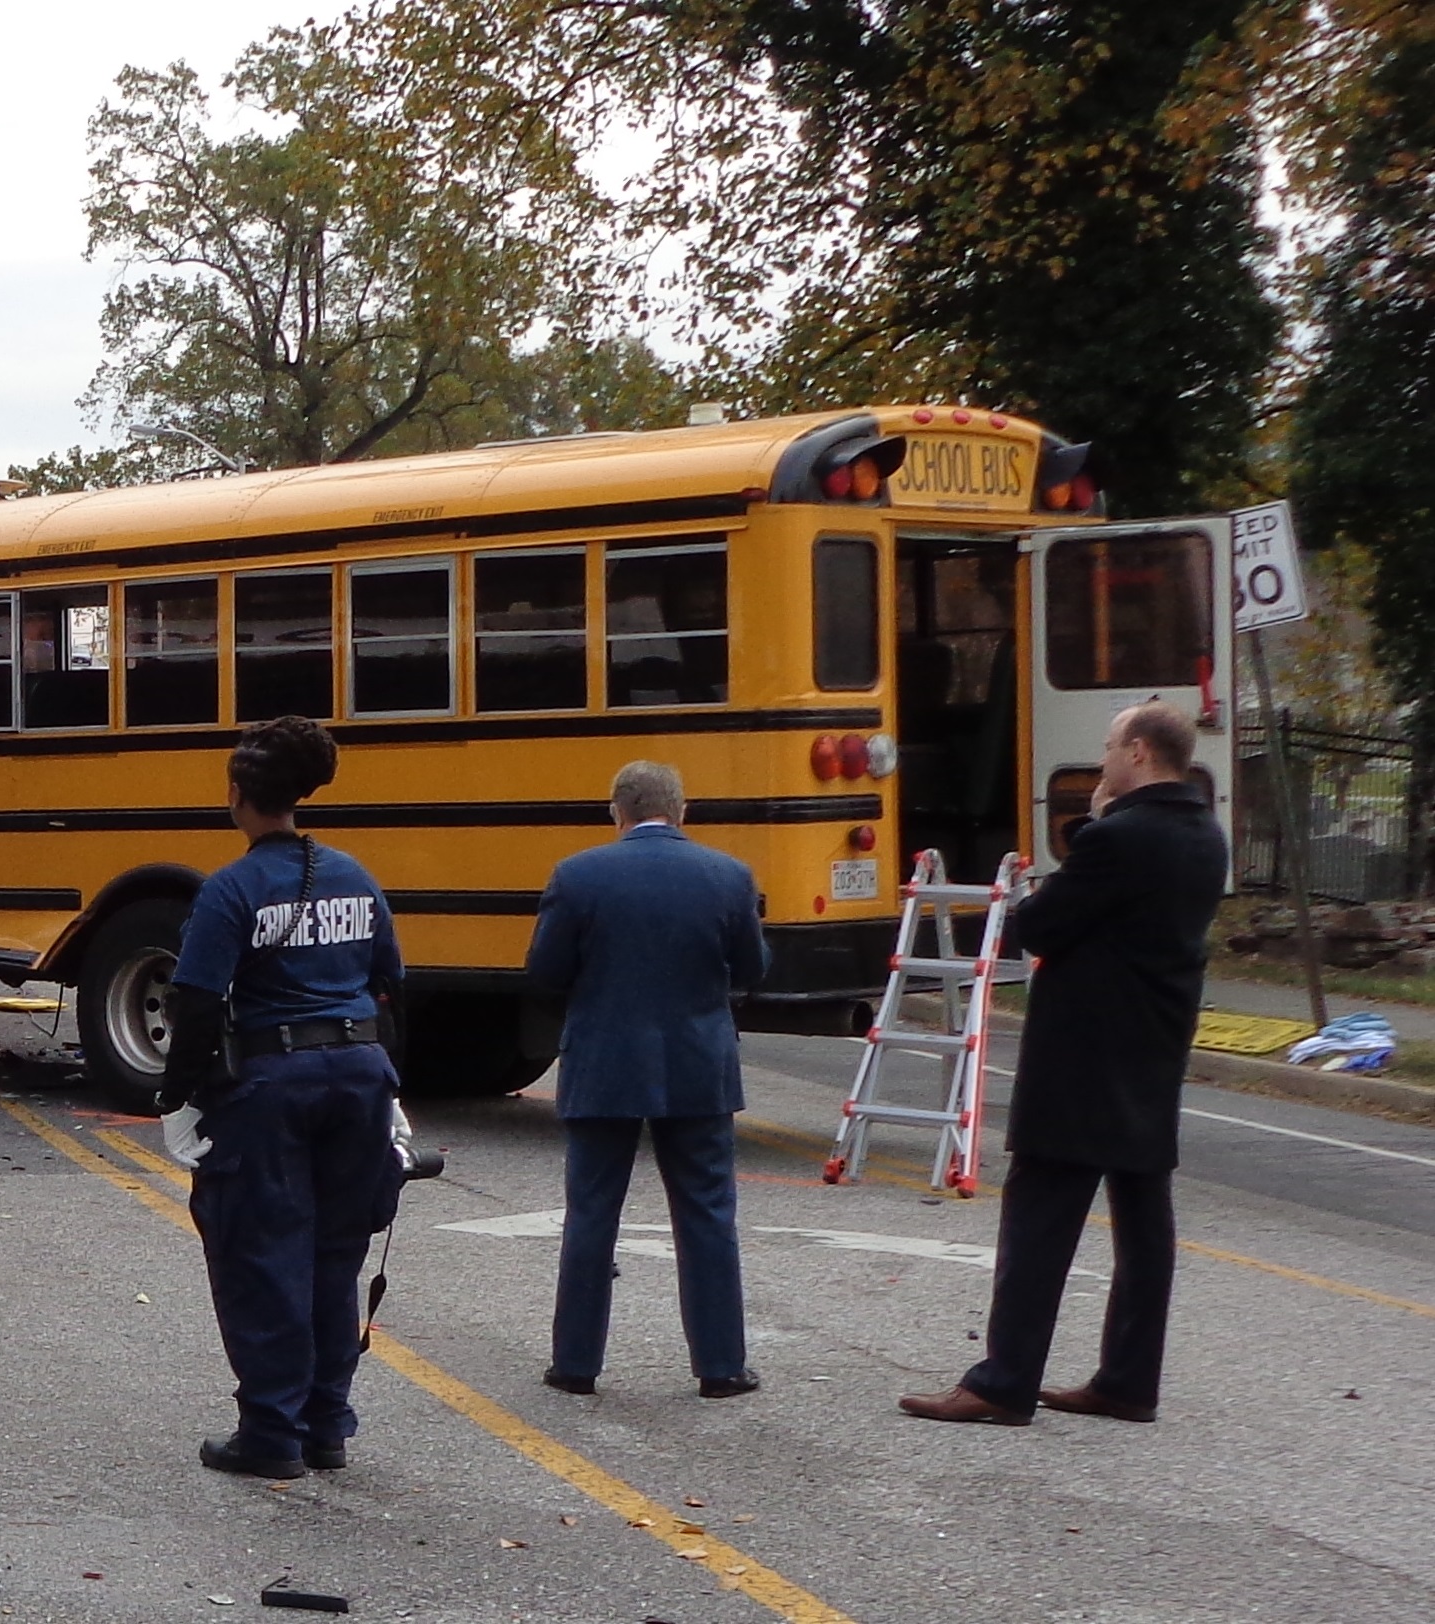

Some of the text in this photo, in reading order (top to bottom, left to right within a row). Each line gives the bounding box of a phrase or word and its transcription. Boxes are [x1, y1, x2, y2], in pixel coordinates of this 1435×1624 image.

[982, 446, 1021, 496] BUS
[372, 505, 444, 523] EMERGENCY EXIT
[37, 540, 97, 555] EMERGENCY EXIT
[251, 896, 375, 949] CRIME SCENE
